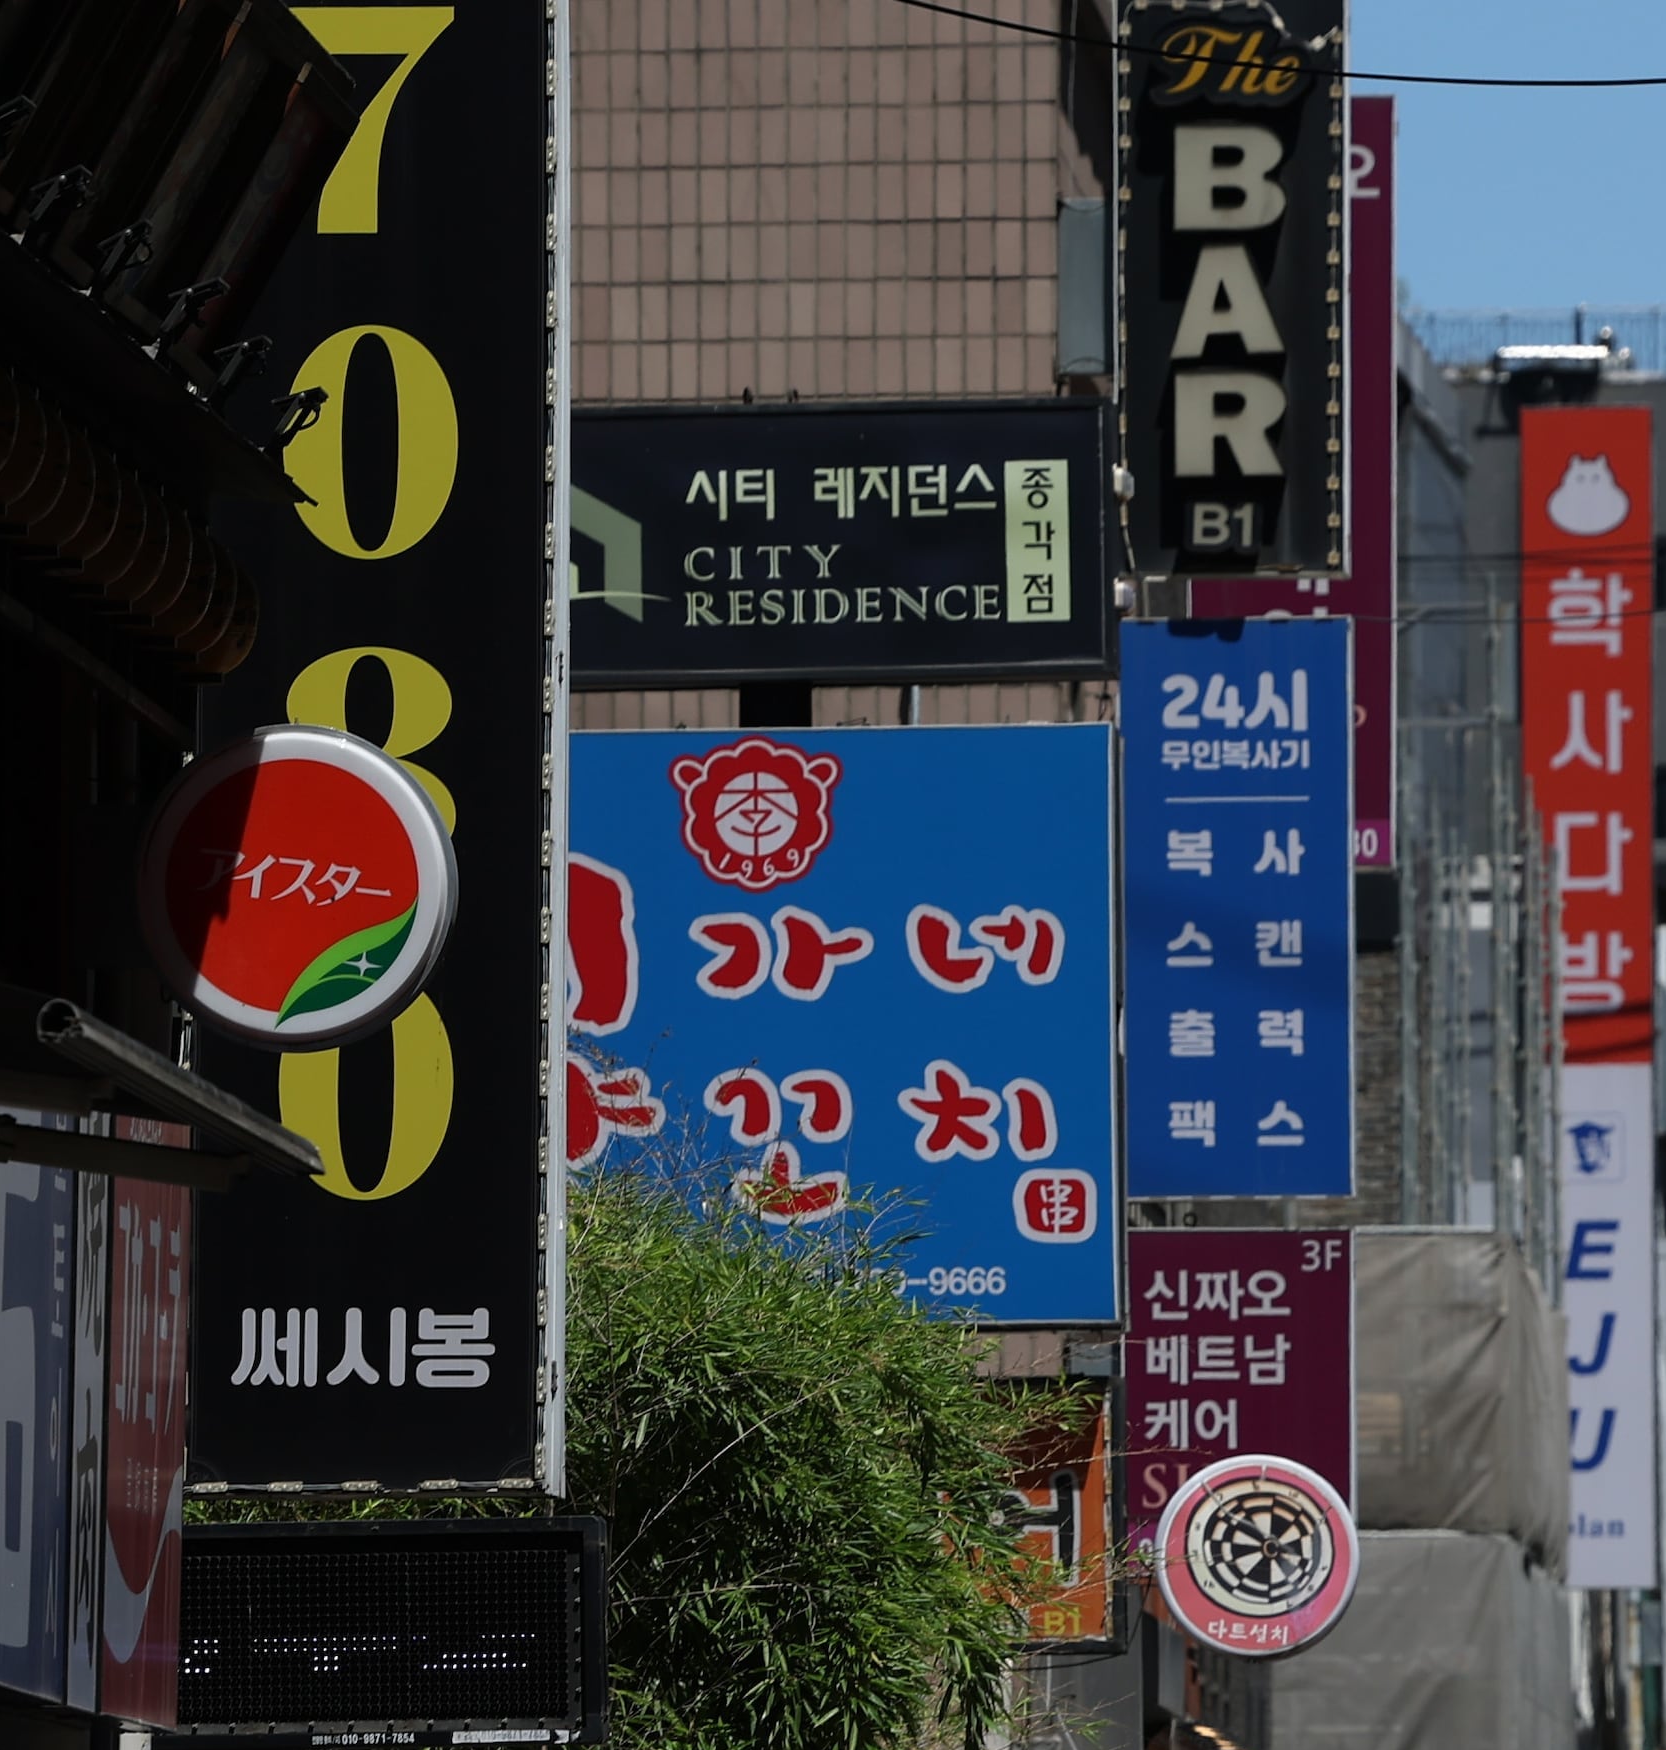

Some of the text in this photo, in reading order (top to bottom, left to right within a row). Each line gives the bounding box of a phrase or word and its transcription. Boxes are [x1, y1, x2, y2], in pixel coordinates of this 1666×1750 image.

[1160, 23, 1303, 97] The
[1170, 123, 1287, 478] BAR
[685, 464, 997, 521] 시티 레지던스
[1021, 467, 1056, 615] 종각점
[1191, 500, 1260, 548] B1
[684, 543, 841, 582] CITY
[684, 583, 1002, 628] RESIDENCE
[1161, 668, 1310, 733] 24시
[1161, 738, 1311, 772] 무인복사기
[1546, 567, 1635, 1016] 학사다방
[718, 847, 800, 878] 1969
[1166, 828, 1306, 877] 복사
[195, 848, 393, 907] アイスター
[1166, 920, 1304, 968] 스캔
[1168, 1008, 1305, 1058] 출력
[1168, 1100, 1305, 1148] 팩스
[1300, 1238, 1343, 1273] 3F
[1143, 1269, 1293, 1322] 신짜오
[231, 1307, 496, 1388] 쎄시봉
[1143, 1333, 1293, 1387] 베트남
[1143, 1398, 1239, 1450] 케어
[1043, 1608, 1084, 1638] B1
[1207, 1620, 1291, 1646] 다트설치
[341, 1732, 416, 1746] 010-9871-7854
